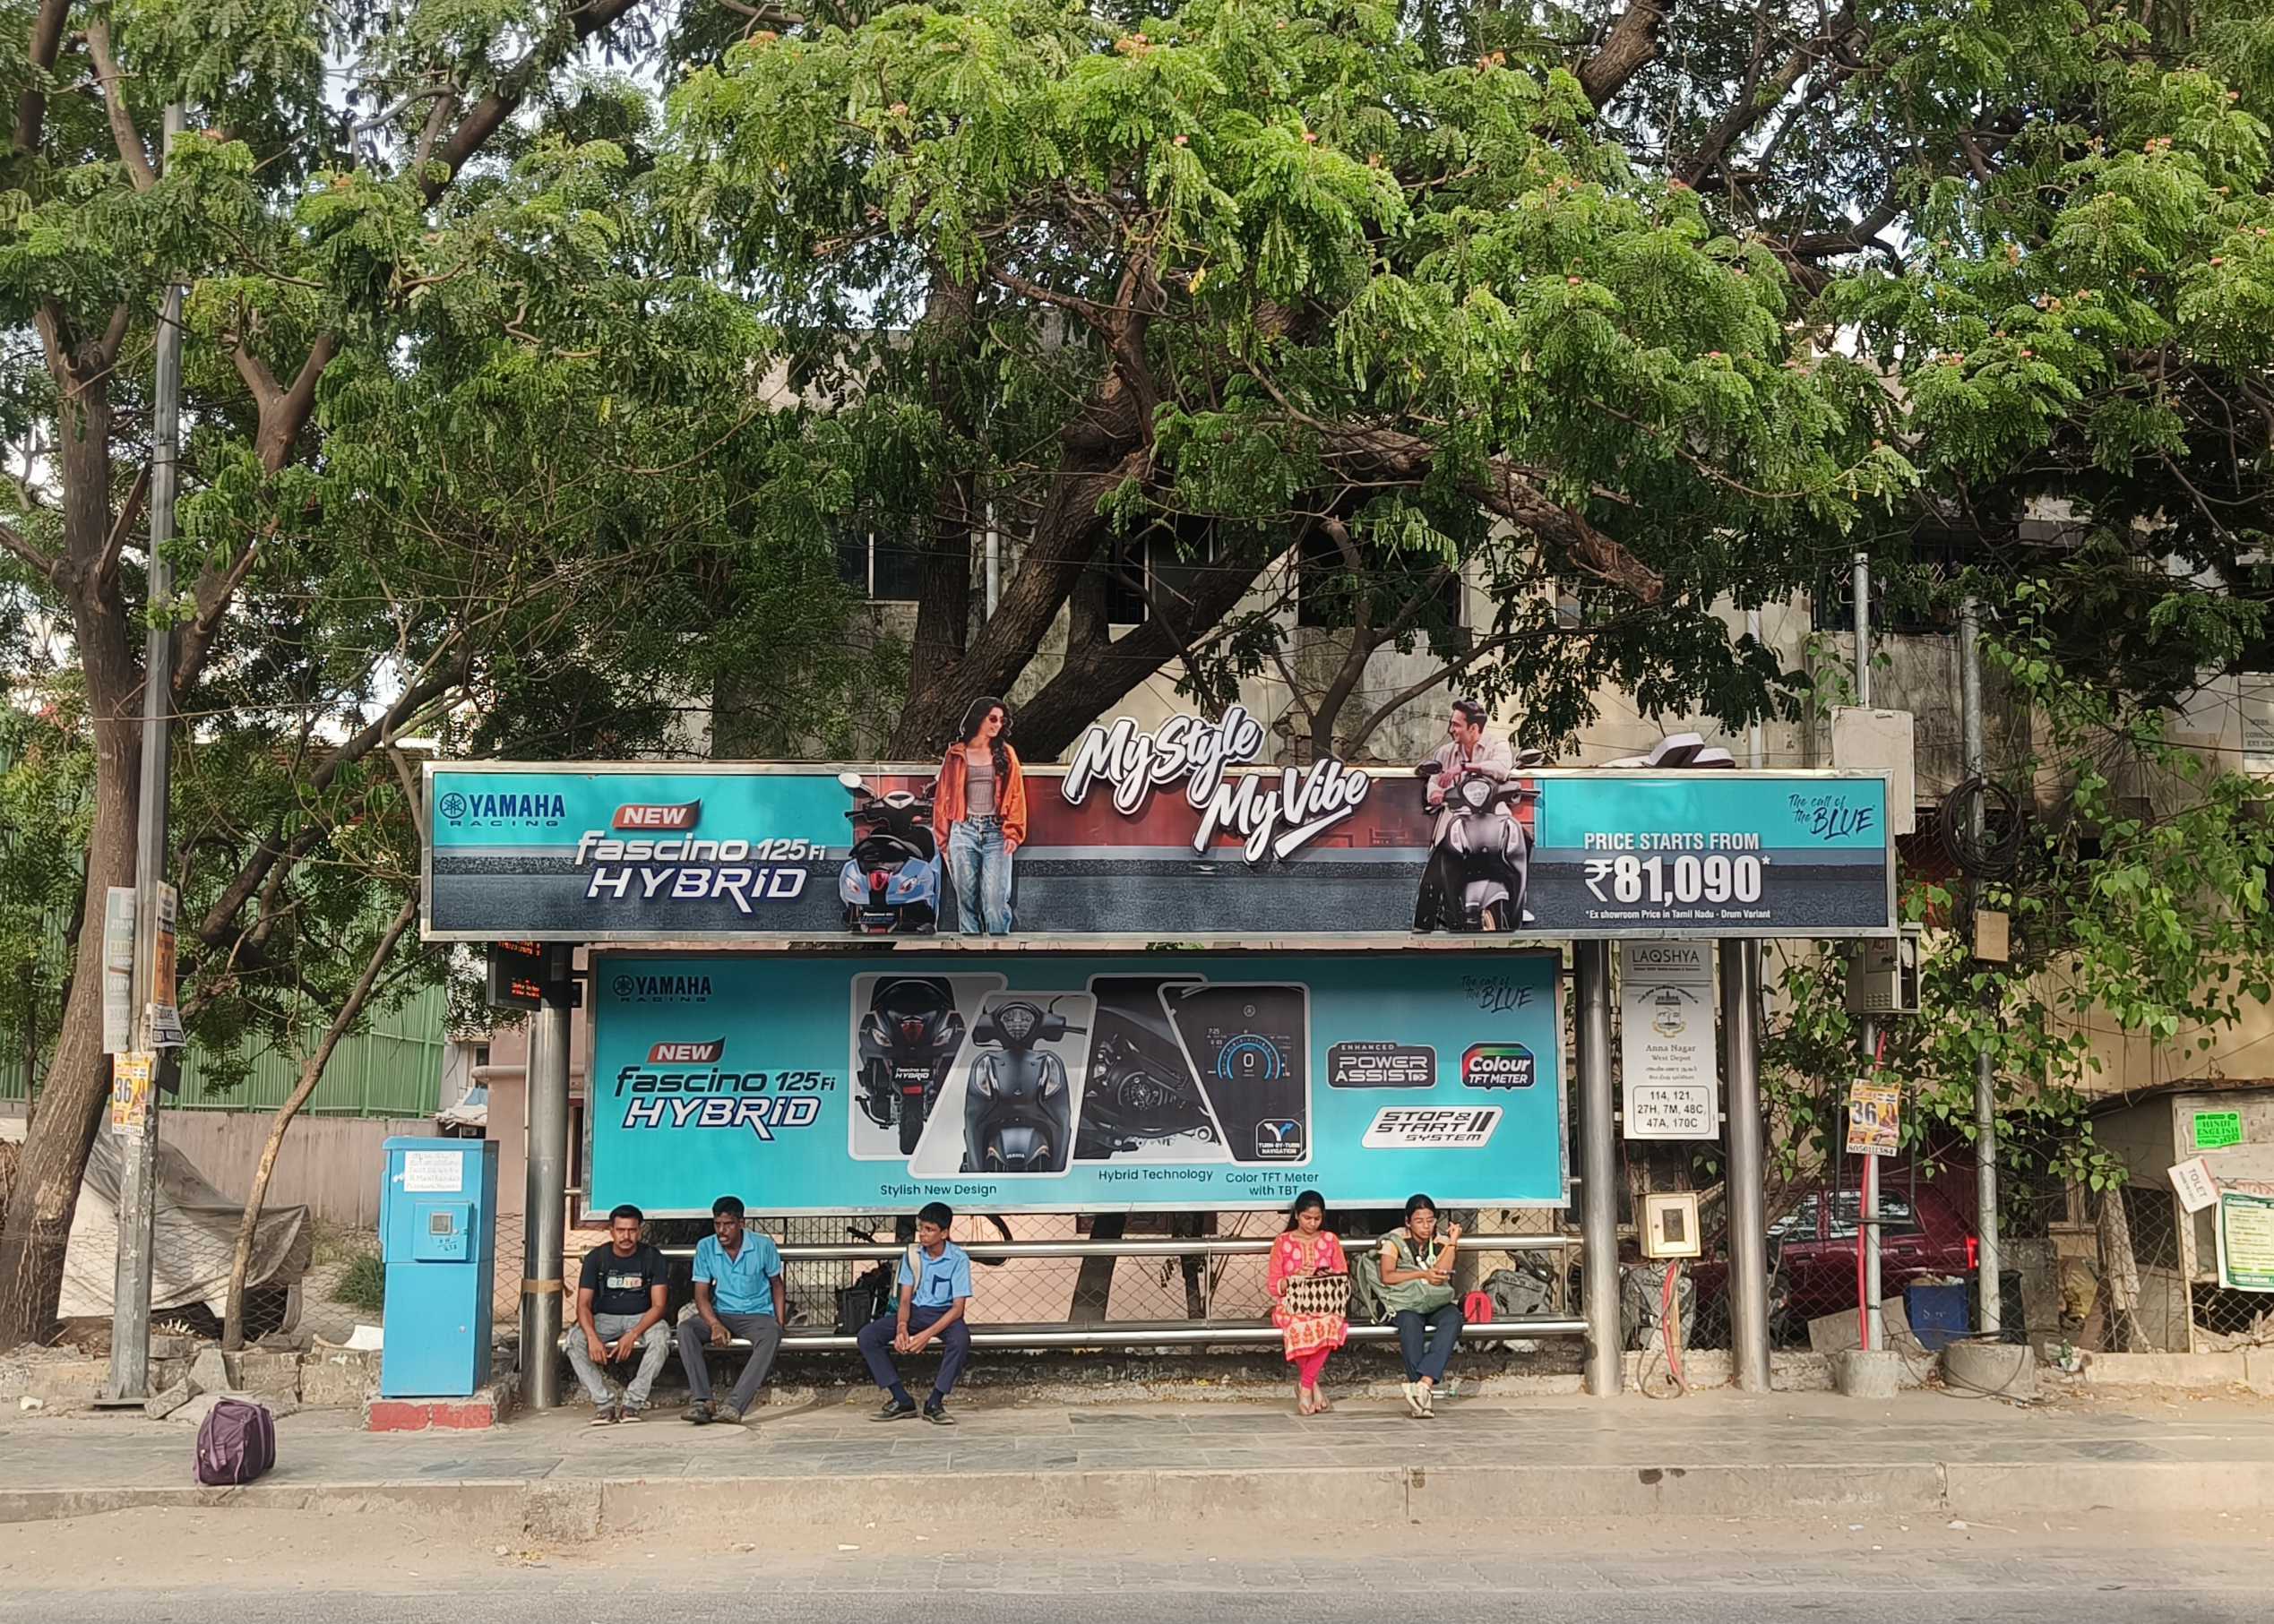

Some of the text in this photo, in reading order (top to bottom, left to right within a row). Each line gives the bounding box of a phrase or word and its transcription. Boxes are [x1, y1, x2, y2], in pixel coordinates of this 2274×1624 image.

[1279, 758, 1369, 825] Vibe
[469, 795, 565, 818] YAMAHA
[1788, 794, 1847, 810] The call of
[623, 807, 688, 825] NEW
[1792, 807, 1874, 840] the BLUE
[574, 830, 826, 865] fascino 125 Fi
[1584, 832, 1760, 850] PRICE STARTS FROM
[1600, 909, 1640, 919] showroom
[1641, 909, 1661, 919] Price
[1662, 909, 1671, 919] in
[1672, 909, 1693, 919] Tamil
[1694, 909, 1715, 919] Nadu
[1720, 909, 1742, 919] Drum
[1744, 909, 1770, 919] Variant
[1632, 949, 1700, 963] LAQSHYA
[636, 975, 711, 997] YAMAHA
[1478, 985, 1534, 1013] BLUE
[657, 1045, 713, 1061] NEW
[1646, 1044, 1696, 1053] Anna Nagar
[1339, 1056, 1428, 1069] POWER
[1469, 1056, 1532, 1073] Colour
[615, 1067, 836, 1096] fascino 125 Fi
[1335, 1069, 1428, 1082] ASSIST
[1469, 1074, 1529, 1084] TFT METER
[115, 1077, 133, 1104] 36
[1650, 1091, 1693, 1102] 114, 121,
[1663, 1104, 1682, 1115] 7M,
[1684, 1104, 1706, 1115] 48C,
[1852, 1100, 1877, 1126] 36
[1375, 1122, 1466, 1133] START
[1647, 1118, 1699, 1129] 47A, 170C
[1405, 1133, 1482, 1142] SYSTEM
[1098, 1167, 1213, 1184] Hybrid Technology
[1226, 1172, 1320, 1184] Color TFT Meter
[881, 1182, 997, 1199] Stylish New Design
[1249, 1184, 1300, 1197] with TBT
